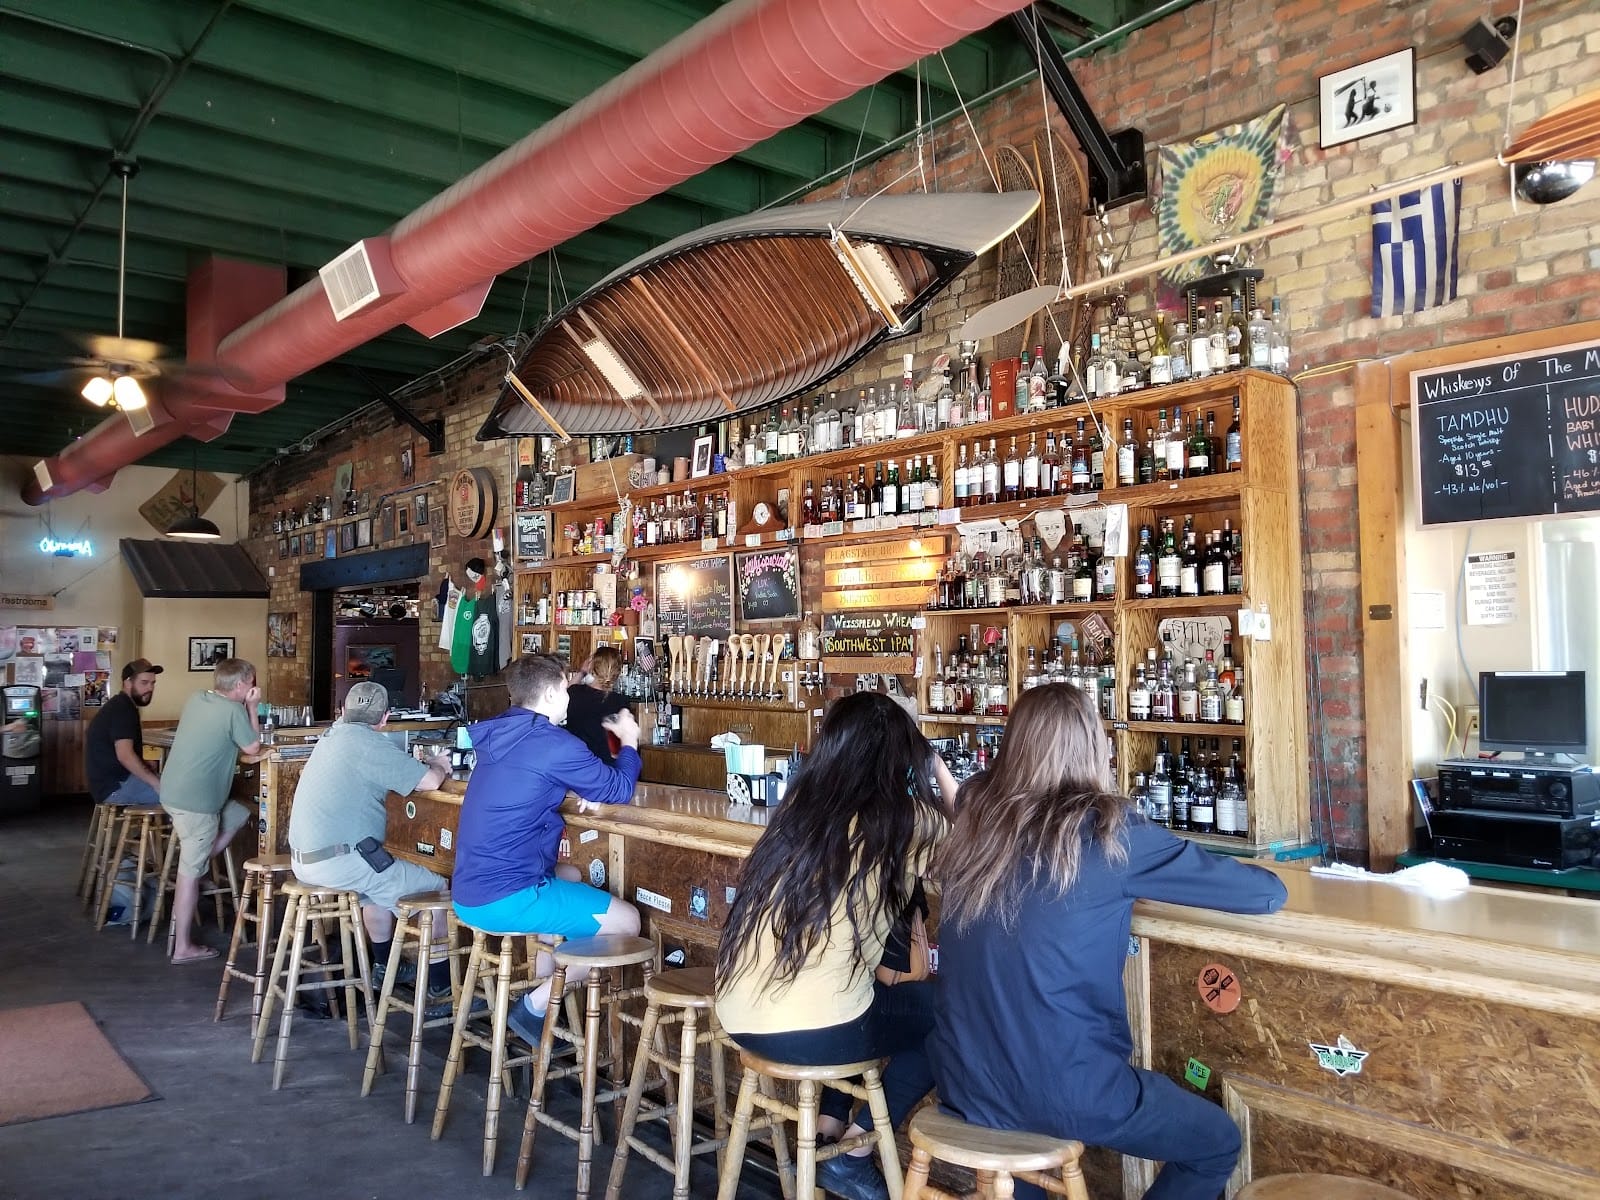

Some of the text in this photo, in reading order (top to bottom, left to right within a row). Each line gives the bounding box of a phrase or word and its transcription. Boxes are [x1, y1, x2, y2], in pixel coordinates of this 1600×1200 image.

[1424, 374, 1492, 400] Whiskeys
[1502, 361, 1521, 382] Of
[1538, 357, 1573, 376] The
[1436, 406, 1509, 432] TAMDHU
[1566, 420, 1595, 433] BABY
[1451, 442, 1475, 451] Scotch
[1465, 451, 1474, 460] 10
[1475, 448, 1494, 461] years
[1468, 478, 1499, 494] alc/vol
[1563, 479, 1588, 494] Aged
[830, 546, 876, 560] FLAGSTAFF
[1479, 553, 1508, 563] WARNING
[1, 597, 48, 606] restrooms
[883, 612, 913, 628] WHEA
[1087, 620, 1105, 642] DEAD
[828, 636, 909, 653] SOUTHWEST IPA
[637, 889, 652, 902] Peace
